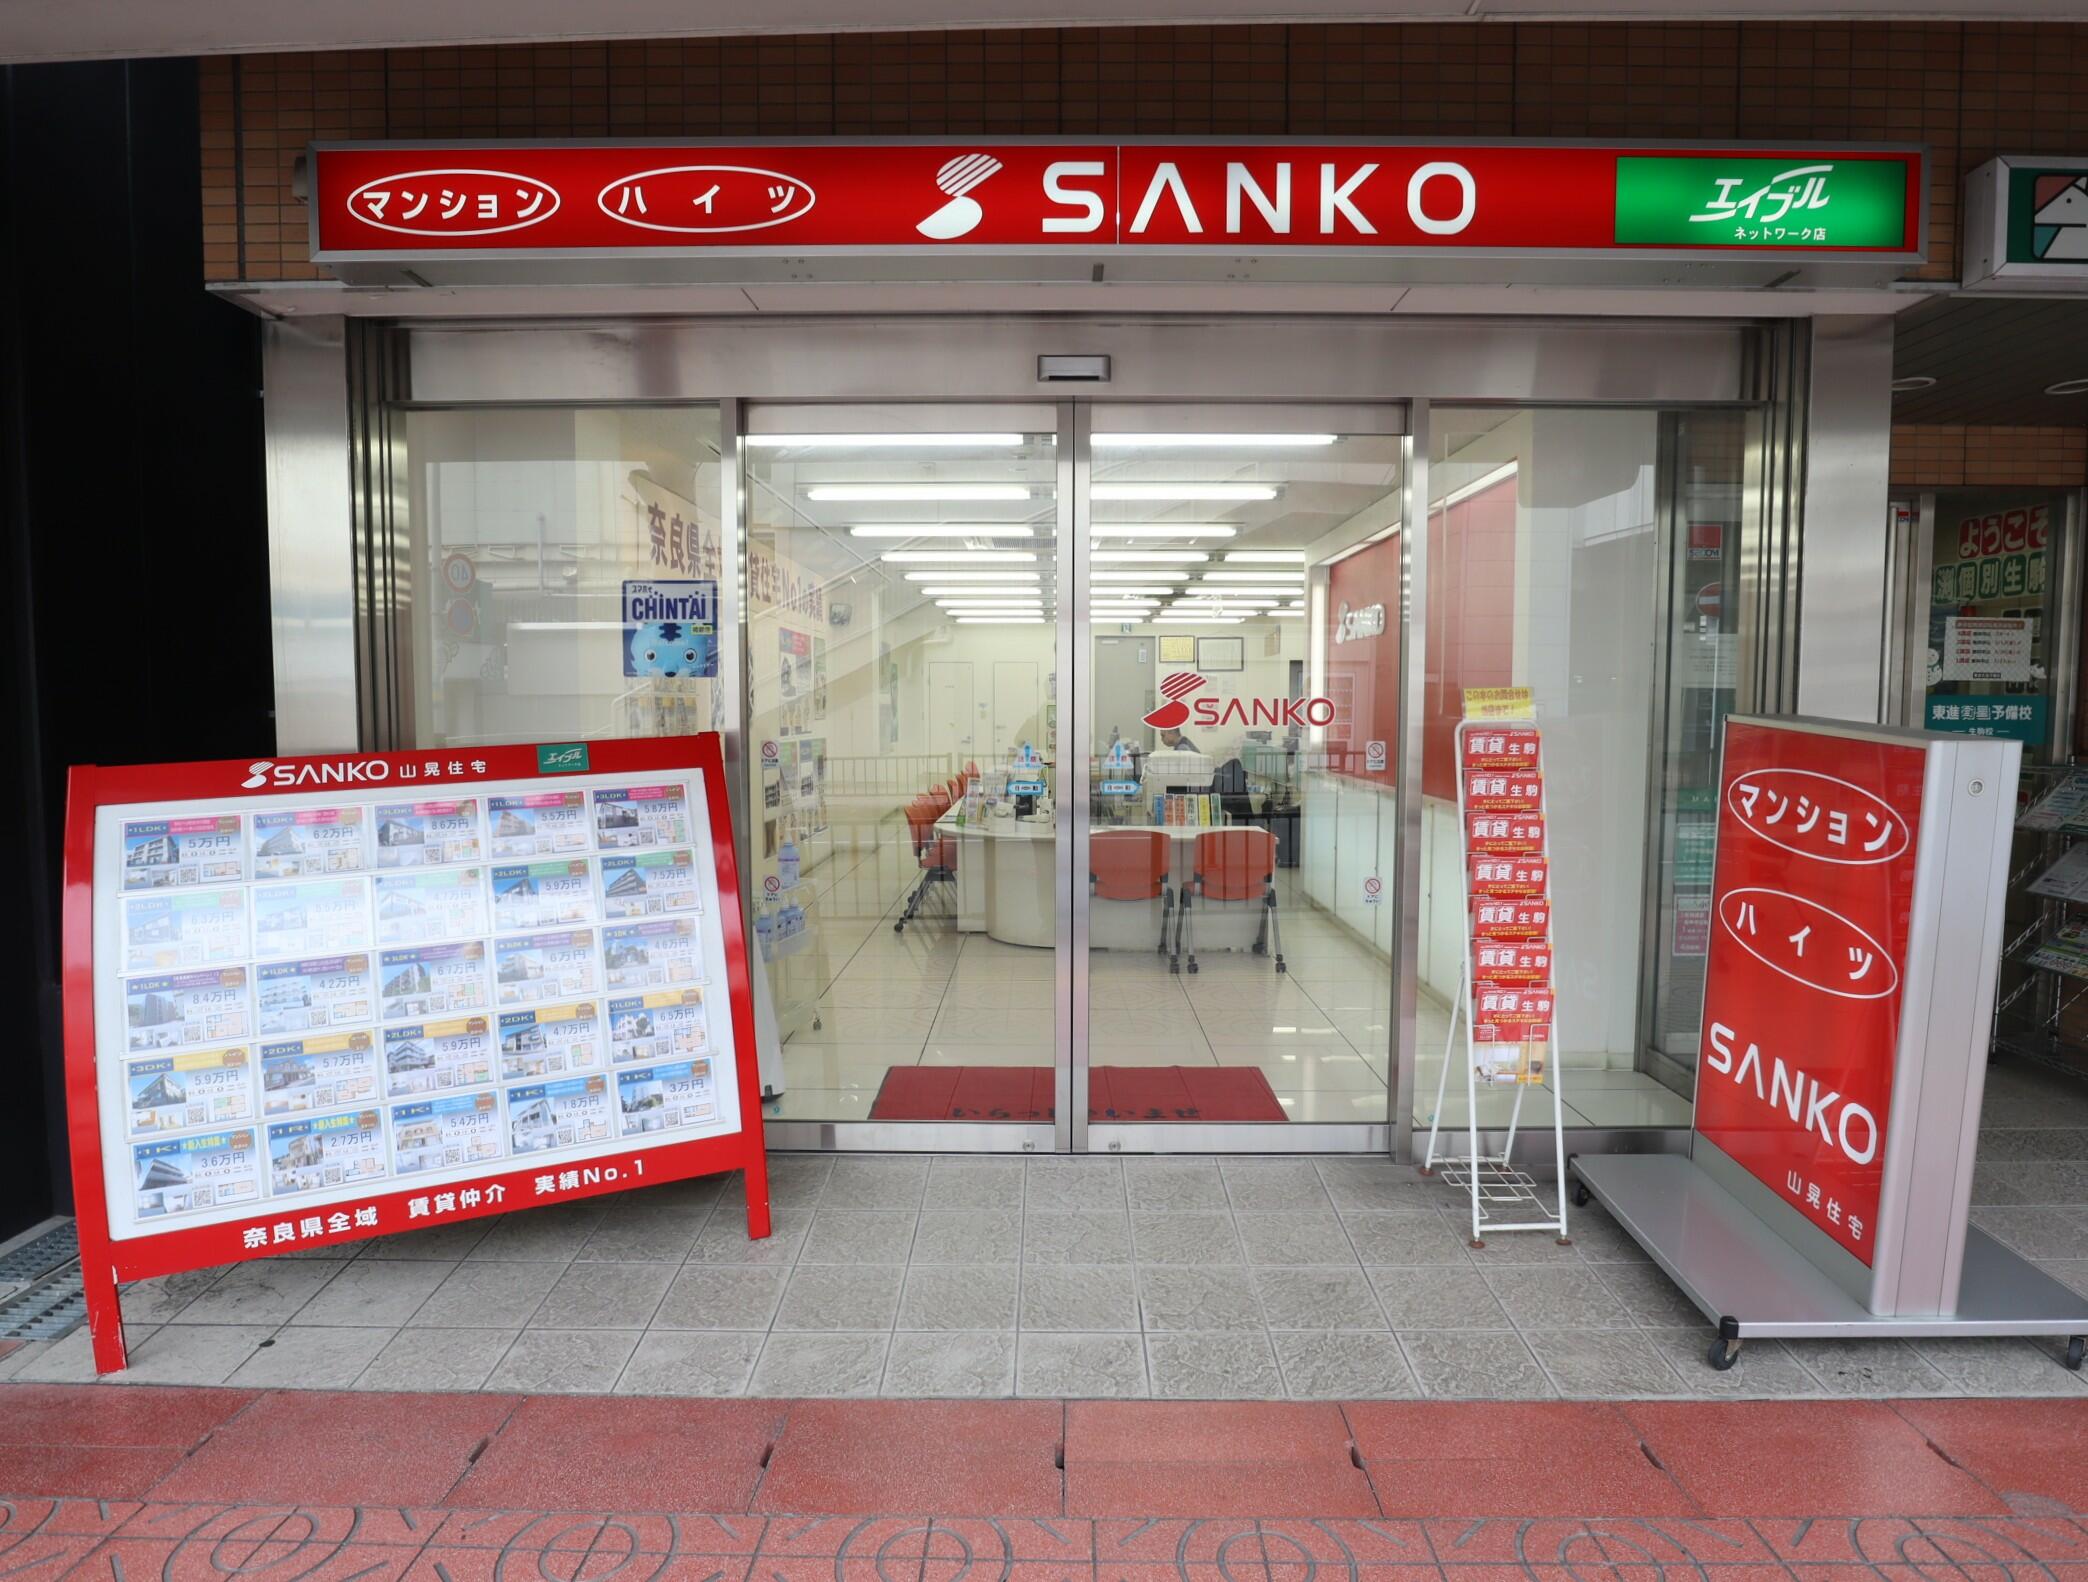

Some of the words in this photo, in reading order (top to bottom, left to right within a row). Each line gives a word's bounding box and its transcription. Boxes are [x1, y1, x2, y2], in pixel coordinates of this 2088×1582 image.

[363, 189, 543, 220] マンション
[618, 185, 795, 215] ハイツ
[1042, 161, 1477, 235] SANKO
[1689, 165, 1834, 222] エイブル
[1734, 226, 1827, 241] ネットワーク店
[648, 501, 722, 580] 奈良県全
[1194, 698, 1336, 727] SANKO
[1931, 704, 2032, 720] 東進衛星予備校
[1968, 727, 1994, 736] 生駒校
[273, 760, 389, 786] SANKO
[400, 759, 487, 778] 山晃住宅
[134, 825, 162, 833] 1LDK
[1738, 783, 1893, 852] マンション
[188, 836, 231, 849] 5万円
[1735, 901, 1873, 981] ハイツ
[504, 1015, 529, 1024] 2DK
[323, 1053, 365, 1067] 5.7万円
[195, 1070, 239, 1085] 5.9万円
[669, 1079, 704, 1093] 3万円
[1707, 1022, 1879, 1166] SANKO
[330, 1133, 372, 1147] 2.7万円
[201, 1152, 245, 1168] 3.6万円
[243, 1206, 378, 1250] 奈良県全域
[408, 1184, 506, 1218] 賃貸仲介
[535, 1160, 645, 1195] 実績No.1
[1787, 1169, 1864, 1241] 山晃住宅
